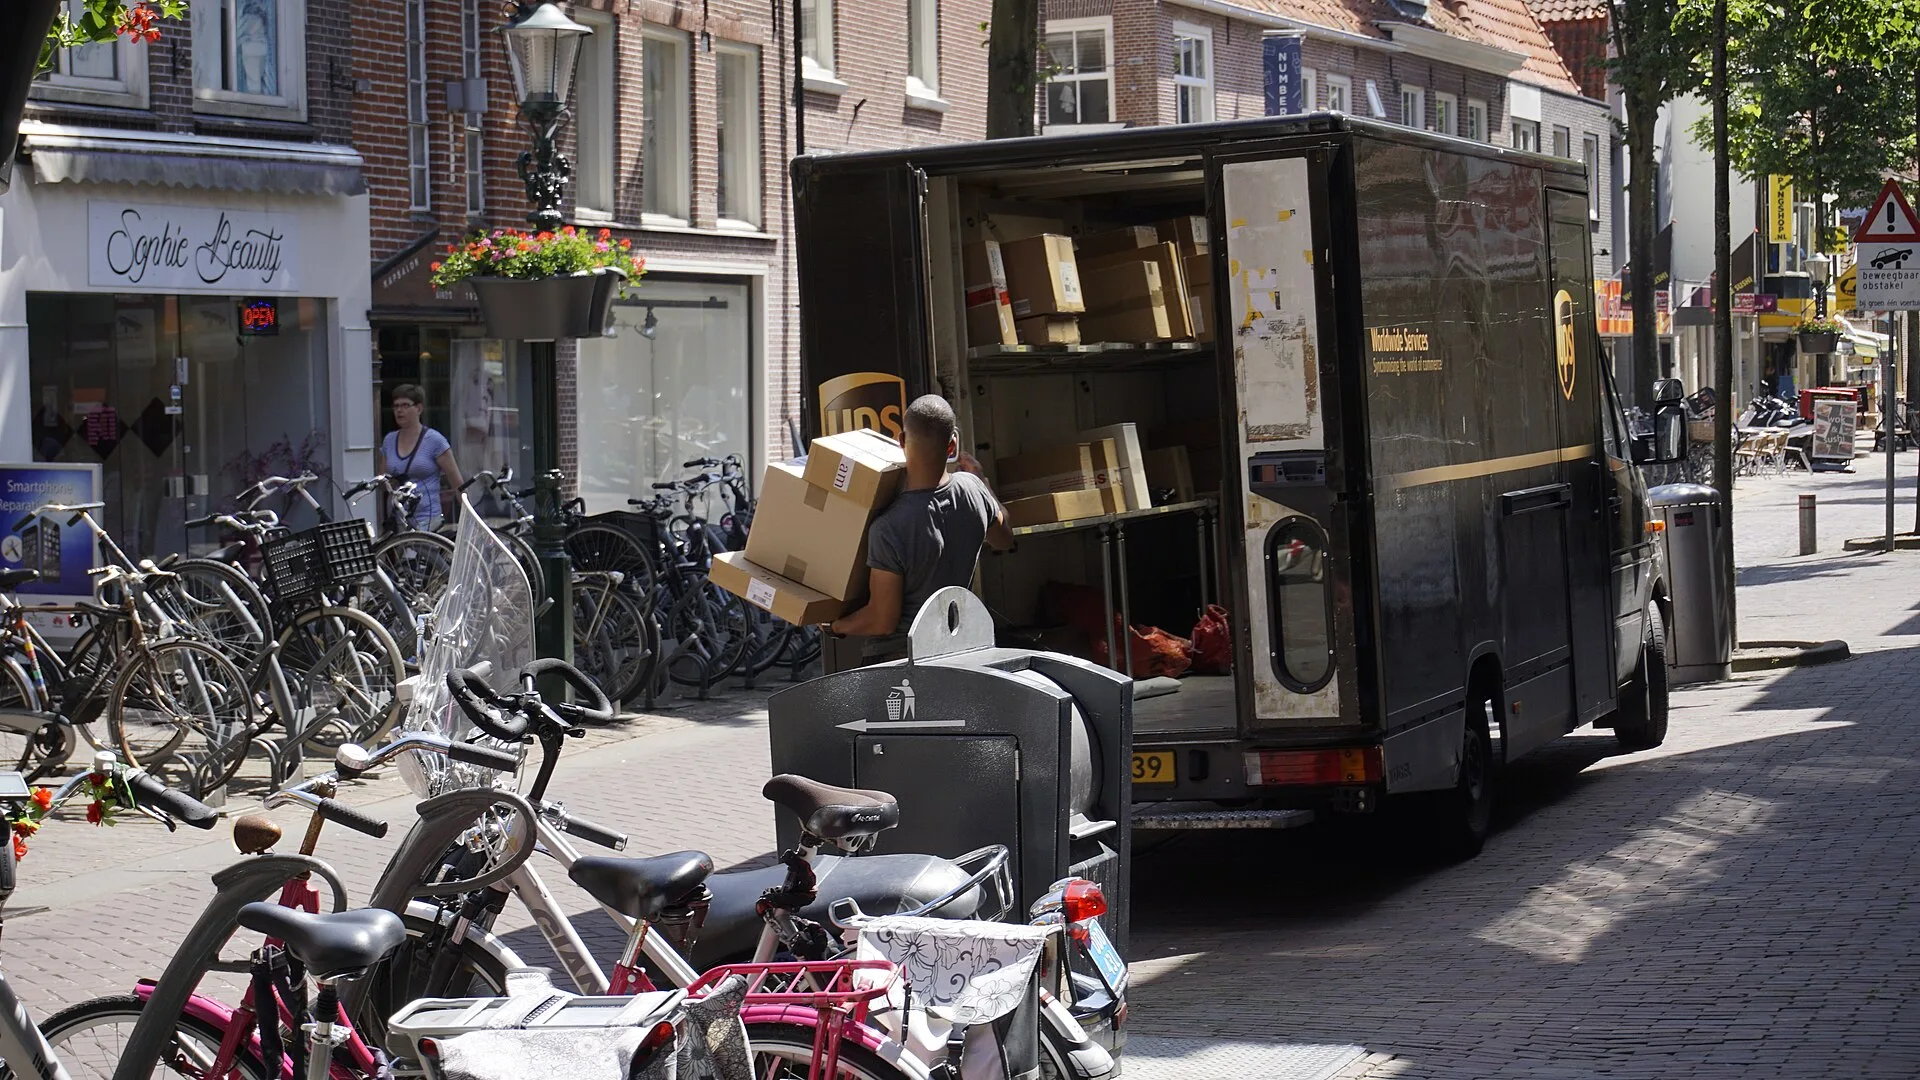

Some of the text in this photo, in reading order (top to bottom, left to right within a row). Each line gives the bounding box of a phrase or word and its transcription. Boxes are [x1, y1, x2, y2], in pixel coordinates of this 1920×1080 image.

[1278, 52, 1289, 116] NUMBER
[107, 209, 284, 284] Sophie Beauty
[1862, 271, 1919, 281] beweegbaar
[1862, 281, 1904, 290] obstakel
[244, 307, 275, 326] OPEN
[1371, 328, 1429, 352] Worldwide Services
[1423, 360, 1443, 371] commerce
[1827, 416, 1846, 425] wok
[1823, 434, 1845, 444] sushi
[7, 479, 74, 496] Smartphone
[1132, 755, 1162, 779] 39
